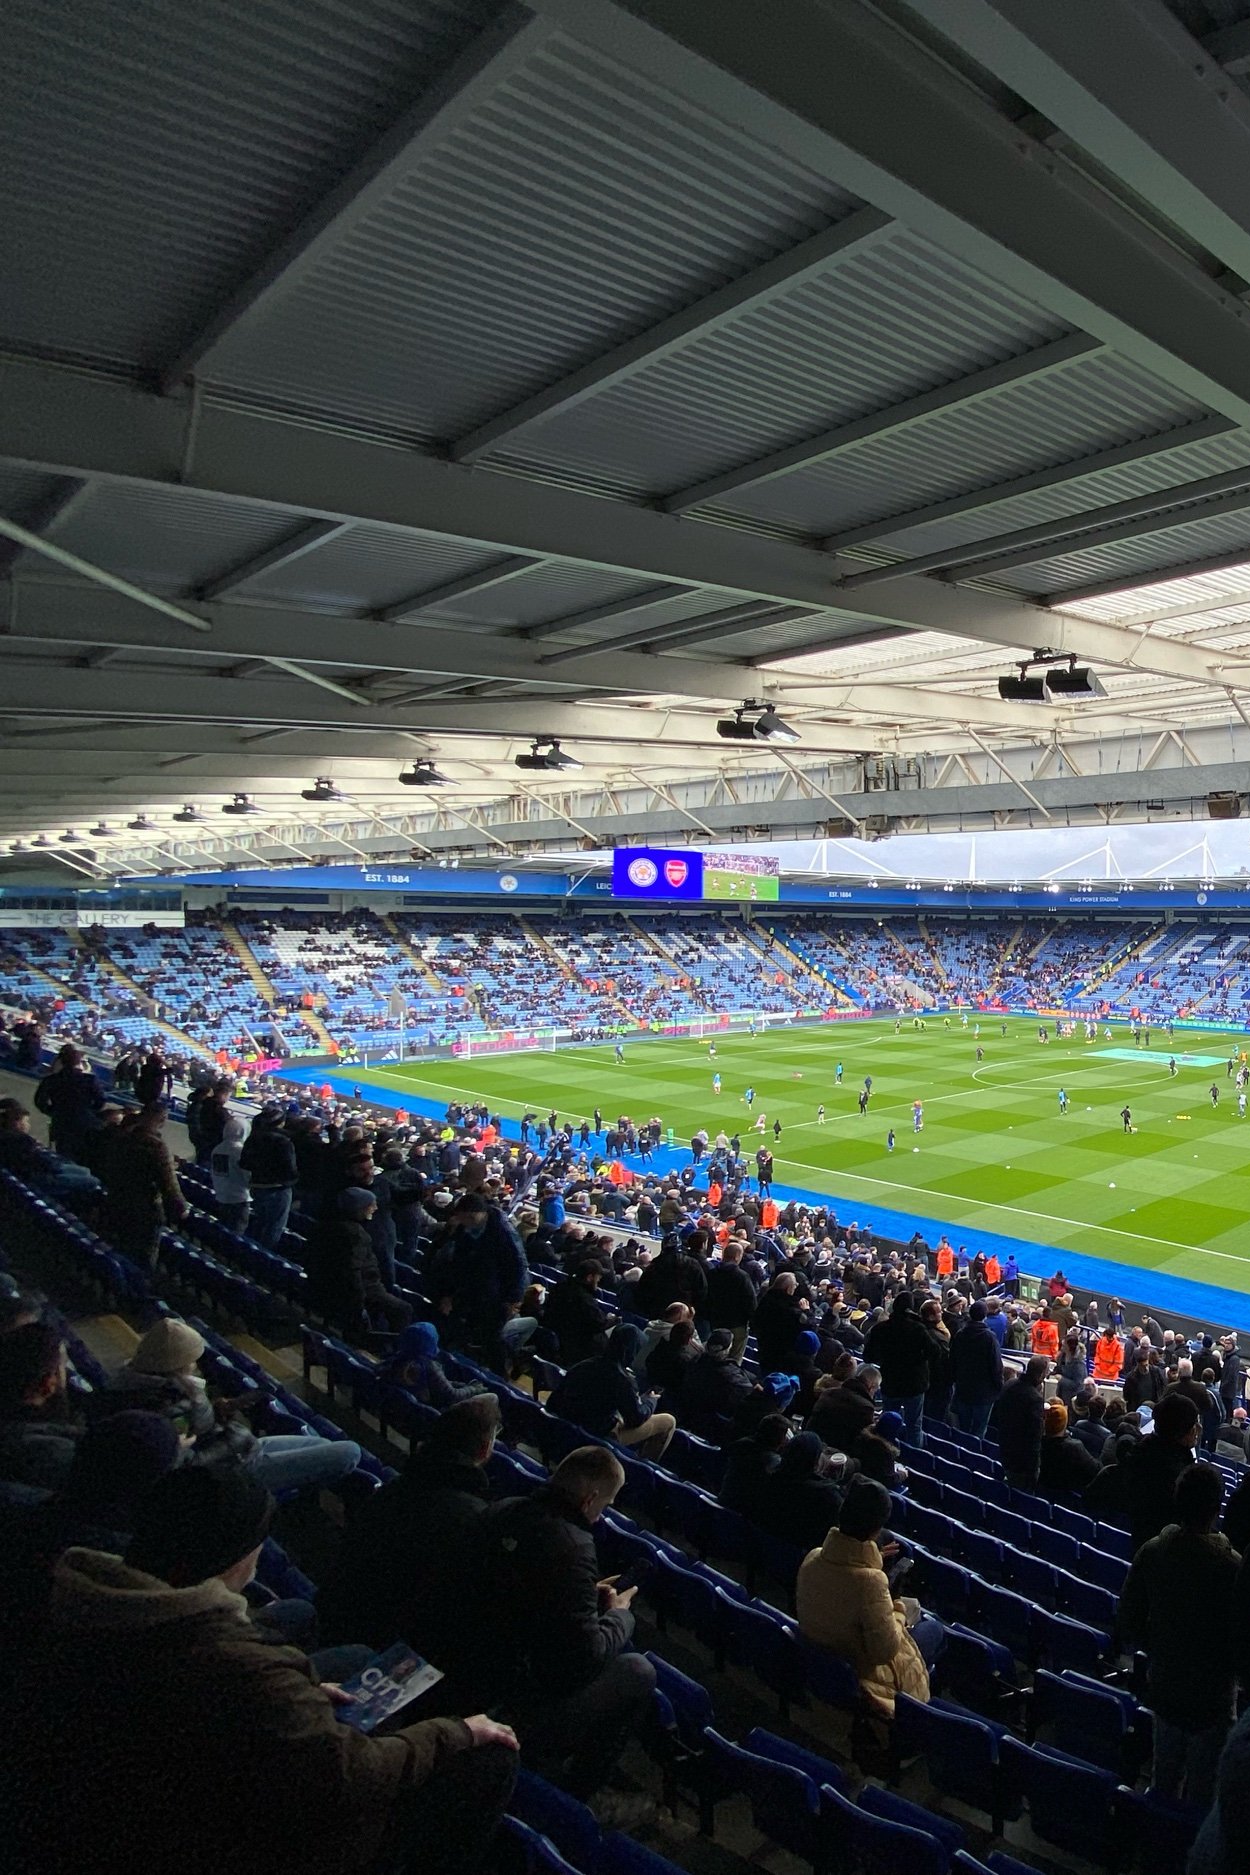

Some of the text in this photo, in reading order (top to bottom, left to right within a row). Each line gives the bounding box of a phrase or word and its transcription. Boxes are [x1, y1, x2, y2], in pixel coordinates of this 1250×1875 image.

[365, 874, 410, 884] EST. 1884
[27, 913, 129, 925] THE GALLERY
